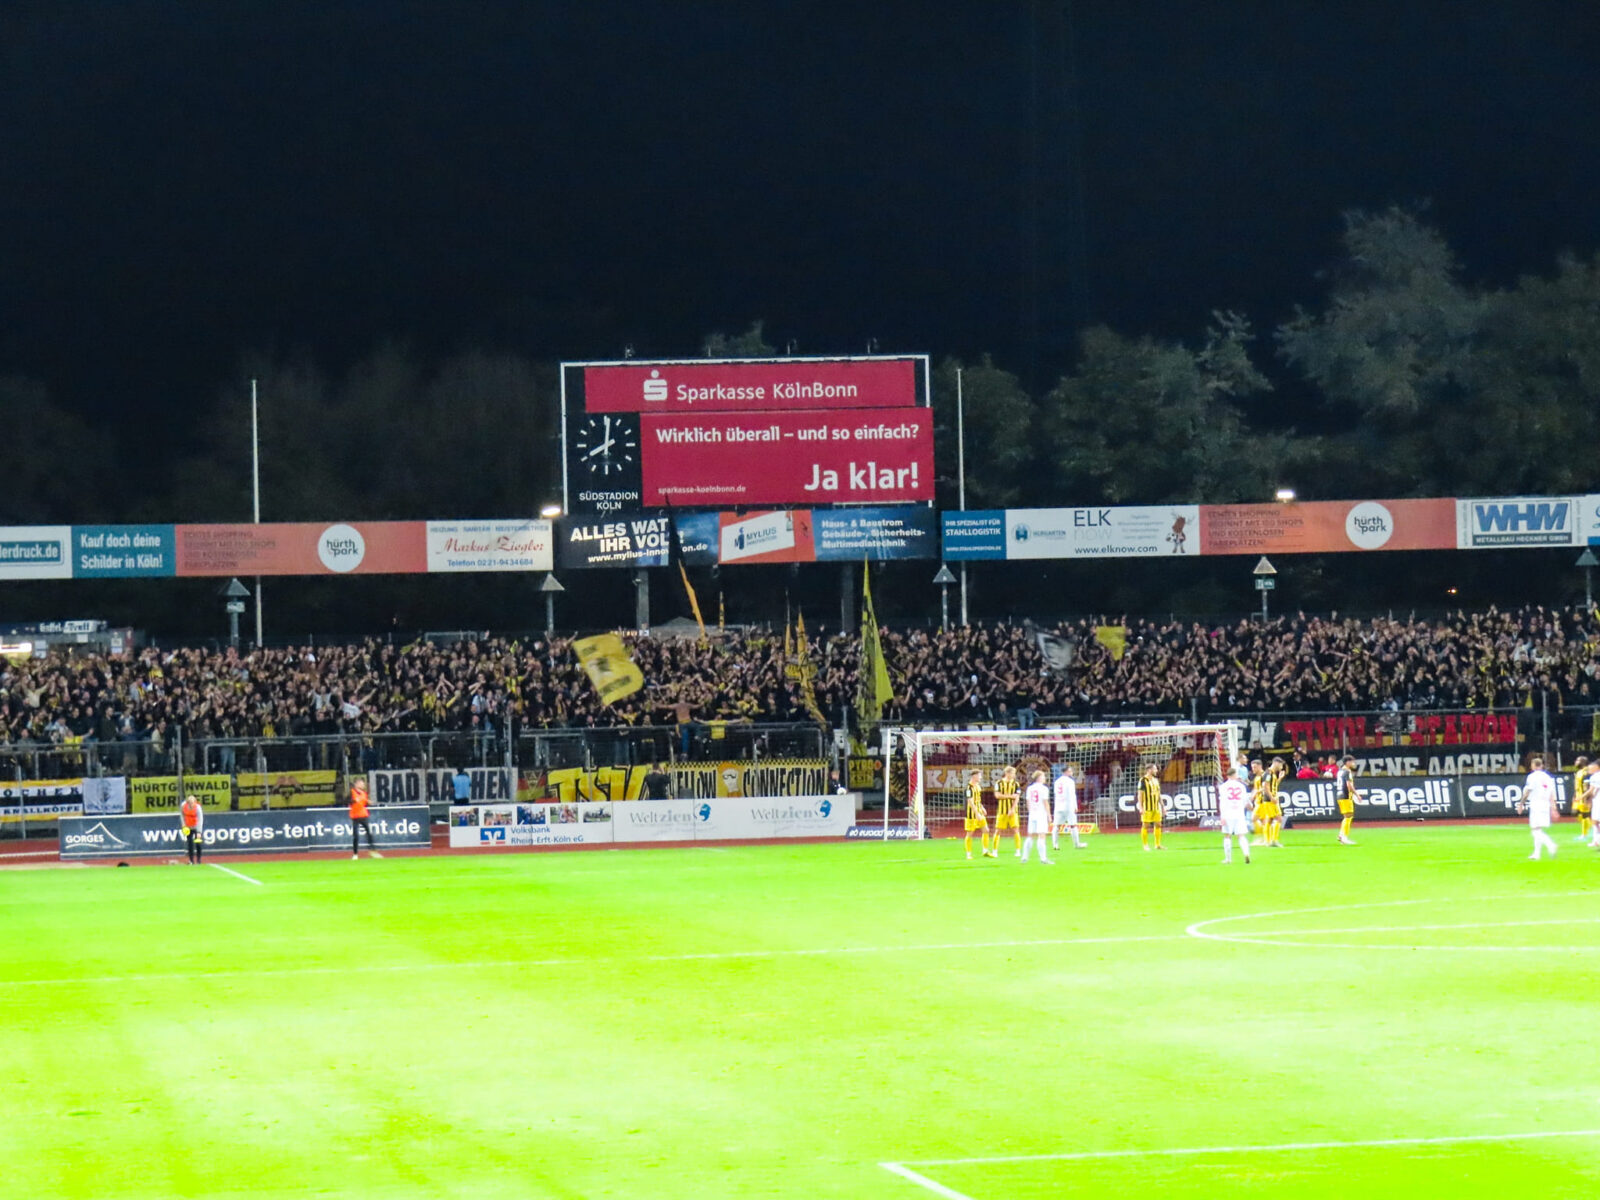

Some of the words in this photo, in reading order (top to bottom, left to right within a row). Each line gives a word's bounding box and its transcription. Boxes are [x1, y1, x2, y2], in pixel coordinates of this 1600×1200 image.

[676, 384, 765, 404] Sparkasse
[773, 382, 858, 399] KölnBonn
[656, 428, 722, 443] Wirklich
[727, 426, 780, 442] überall
[798, 425, 828, 440] und
[832, 428, 850, 440] so
[854, 423, 920, 440] einfach?
[804, 463, 839, 490] Ja
[849, 461, 919, 490] klar!
[579, 491, 639, 502] SÜDSTADION
[596, 500, 623, 511] KÖLN
[1073, 508, 1112, 527] ELK
[1354, 514, 1385, 528] hürth
[1474, 502, 1569, 533] WHM
[569, 523, 627, 542] ALLES
[945, 527, 1002, 537] STAHLLOGISTIK
[1359, 524, 1387, 536] park
[80, 533, 105, 548] Kauf
[106, 533, 132, 548] doch
[133, 531, 161, 547] deine
[326, 538, 356, 552] hürth
[599, 536, 631, 553] IHR
[332, 548, 359, 560] park
[1074, 545, 1158, 555] www.elknow.com
[81, 555, 123, 569] Schilder
[125, 555, 136, 568] in
[137, 553, 163, 569] Köln!
[447, 559, 475, 568] Telefon
[1410, 714, 1518, 746] STADION
[1354, 756, 1420, 777] ZENE
[1428, 753, 1520, 776] AACHEN
[133, 779, 229, 795] HÜRTGNWALD
[375, 773, 421, 803] BAD
[427, 769, 512, 802] AAHEN
[742, 767, 826, 799] CONNECTION
[1118, 786, 1217, 813] cpelli
[1227, 787, 1242, 801] 32
[1352, 778, 1451, 813] capelli
[630, 809, 691, 825] Weltzien
[751, 806, 813, 821] Weltzien
[1165, 809, 1218, 820] SPORT
[1283, 807, 1336, 819] SPORT
[1399, 804, 1451, 817] SPORT
[511, 826, 551, 836] Volksbank
[65, 834, 105, 844] GORGES
[573, 835, 584, 844] eG
